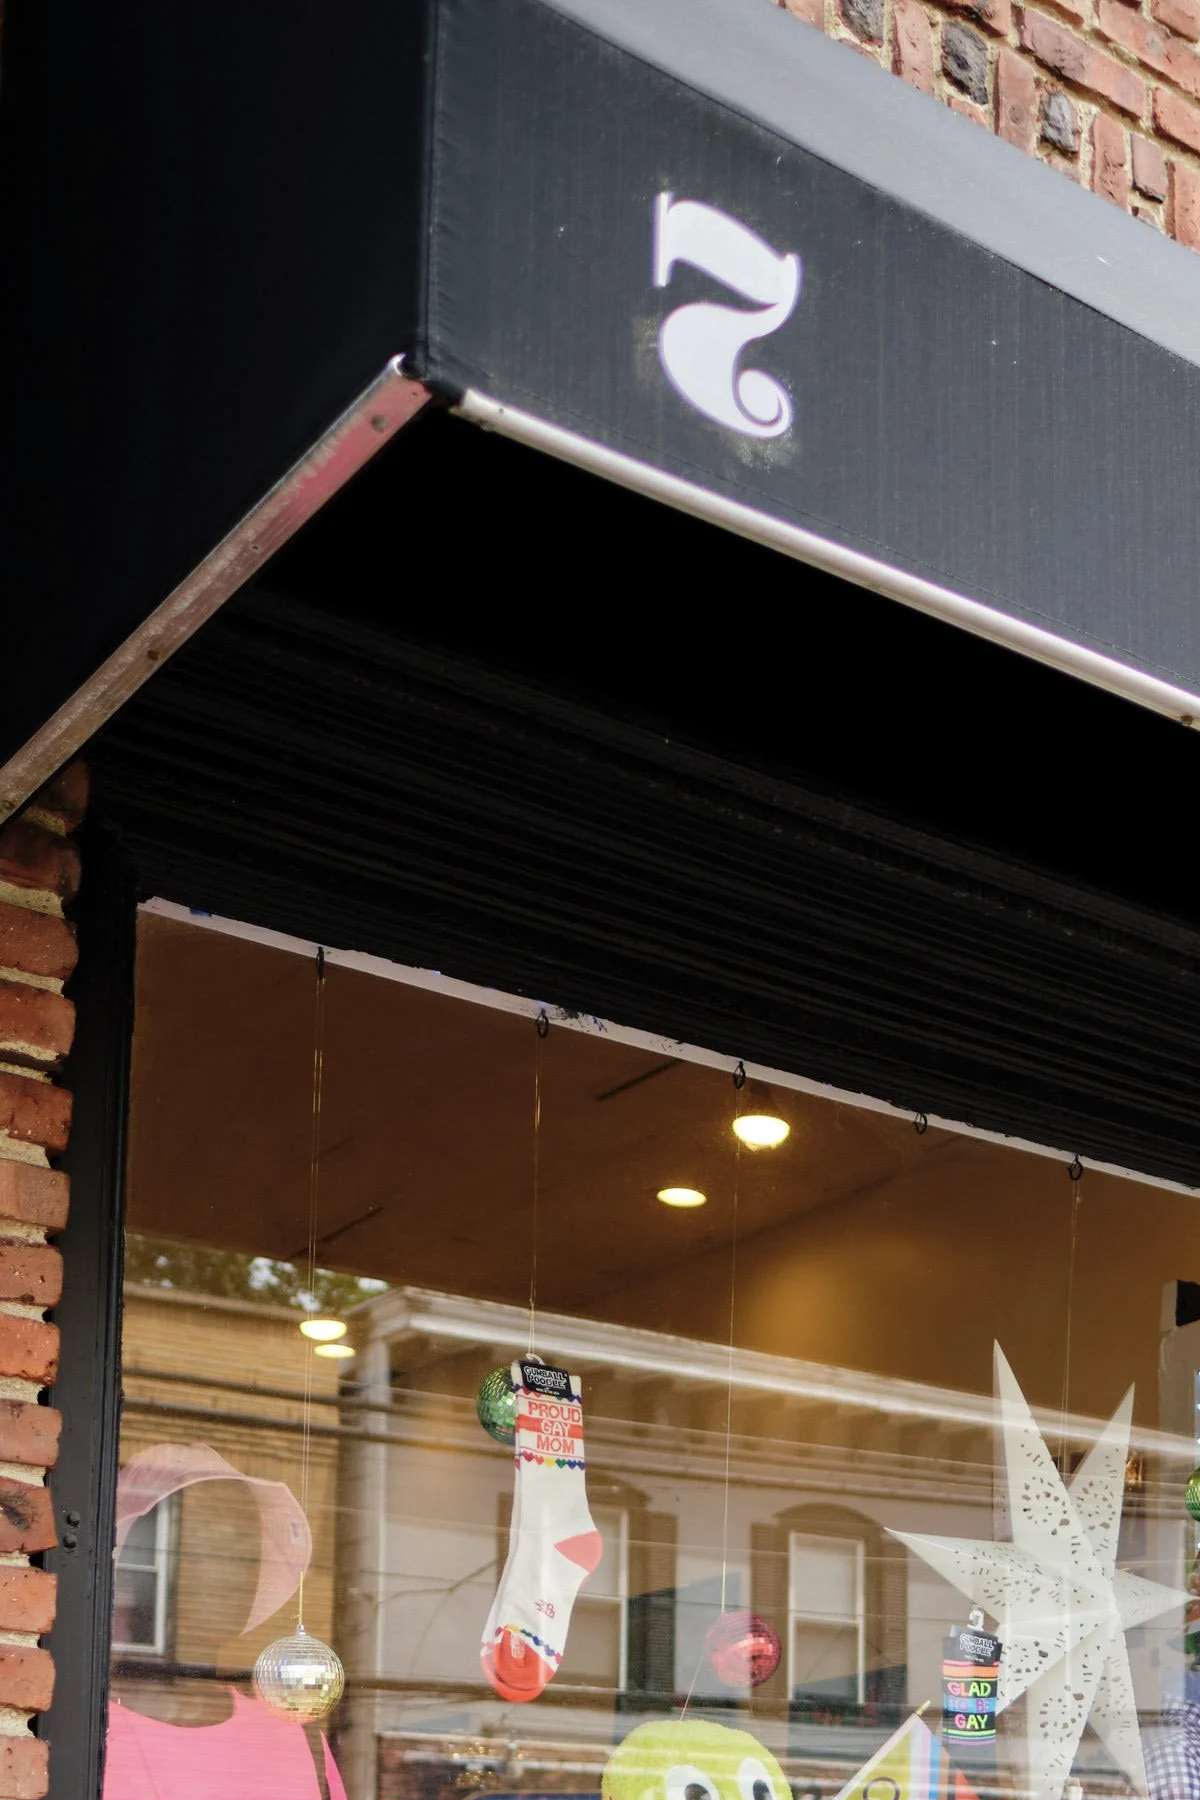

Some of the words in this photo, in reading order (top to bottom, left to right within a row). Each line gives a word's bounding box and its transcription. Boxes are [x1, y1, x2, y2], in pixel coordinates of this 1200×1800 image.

[650, 190, 802, 439] 7
[528, 1401, 581, 1423] PROUD
[541, 1420, 570, 1437] GAY
[536, 1434, 575, 1454] MOM
[947, 1681, 991, 1698] GLAD
[950, 1698, 969, 1712] TO
[975, 1698, 991, 1713] BE
[954, 1714, 988, 1730] GAY
